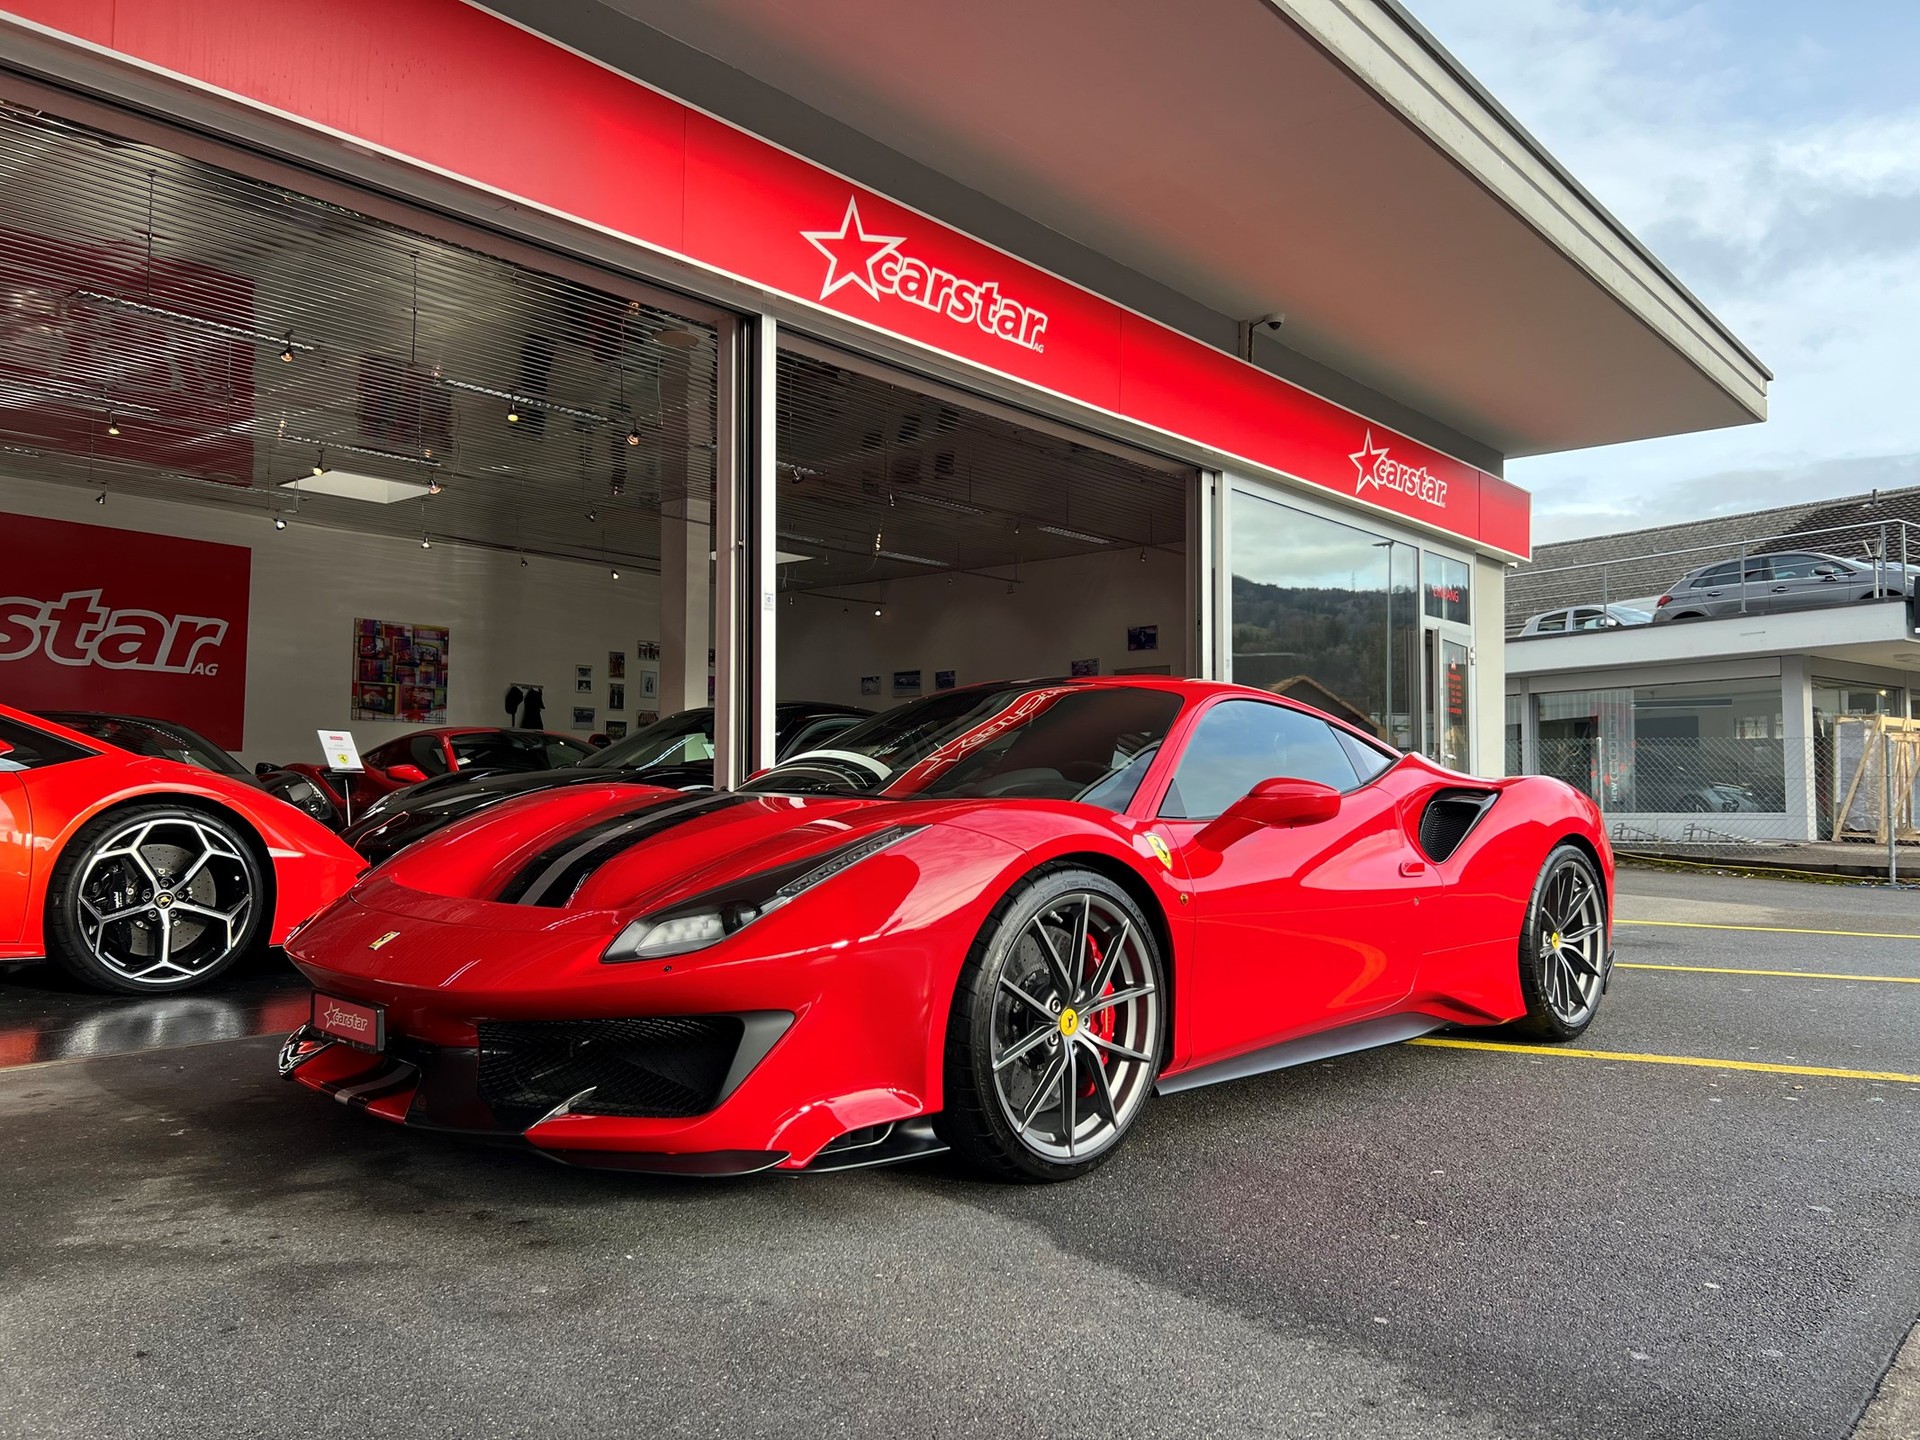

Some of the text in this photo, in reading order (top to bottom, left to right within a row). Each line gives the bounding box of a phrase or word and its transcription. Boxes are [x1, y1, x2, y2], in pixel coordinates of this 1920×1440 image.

[867, 250, 1048, 354] carstar AG
[1374, 457, 1447, 507] carstar
[191, 662, 219, 676] AG
[334, 1010, 367, 1031] carstar
